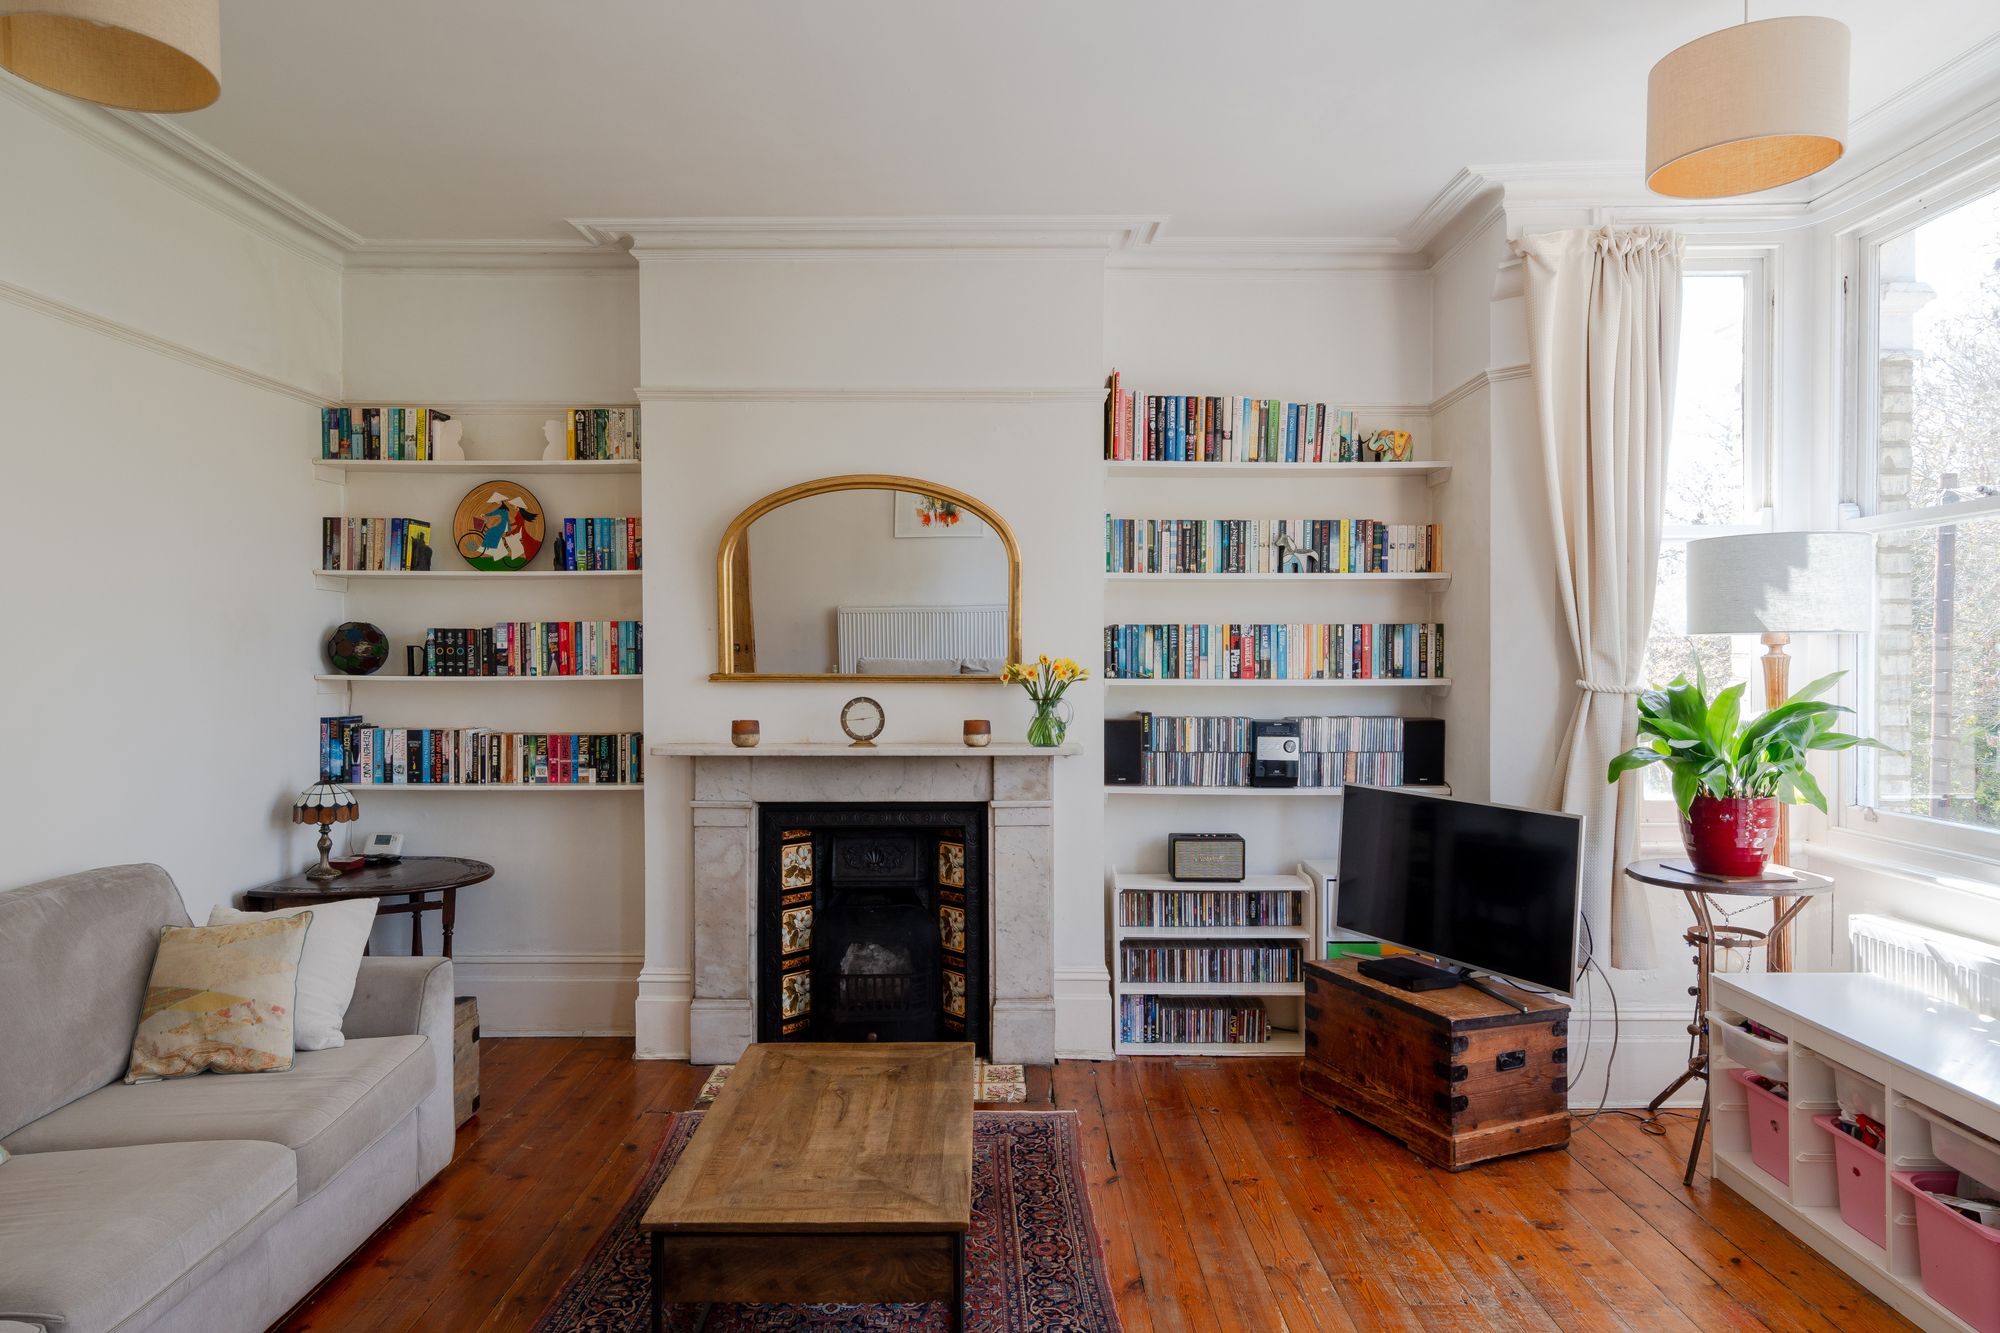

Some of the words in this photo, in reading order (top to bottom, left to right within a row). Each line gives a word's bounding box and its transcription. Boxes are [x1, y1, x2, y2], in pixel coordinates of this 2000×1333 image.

[363, 730, 372, 757] STEPHEN
[538, 738, 546, 756] KING
[580, 737, 588, 754] KING
[363, 763, 372, 778] KING
